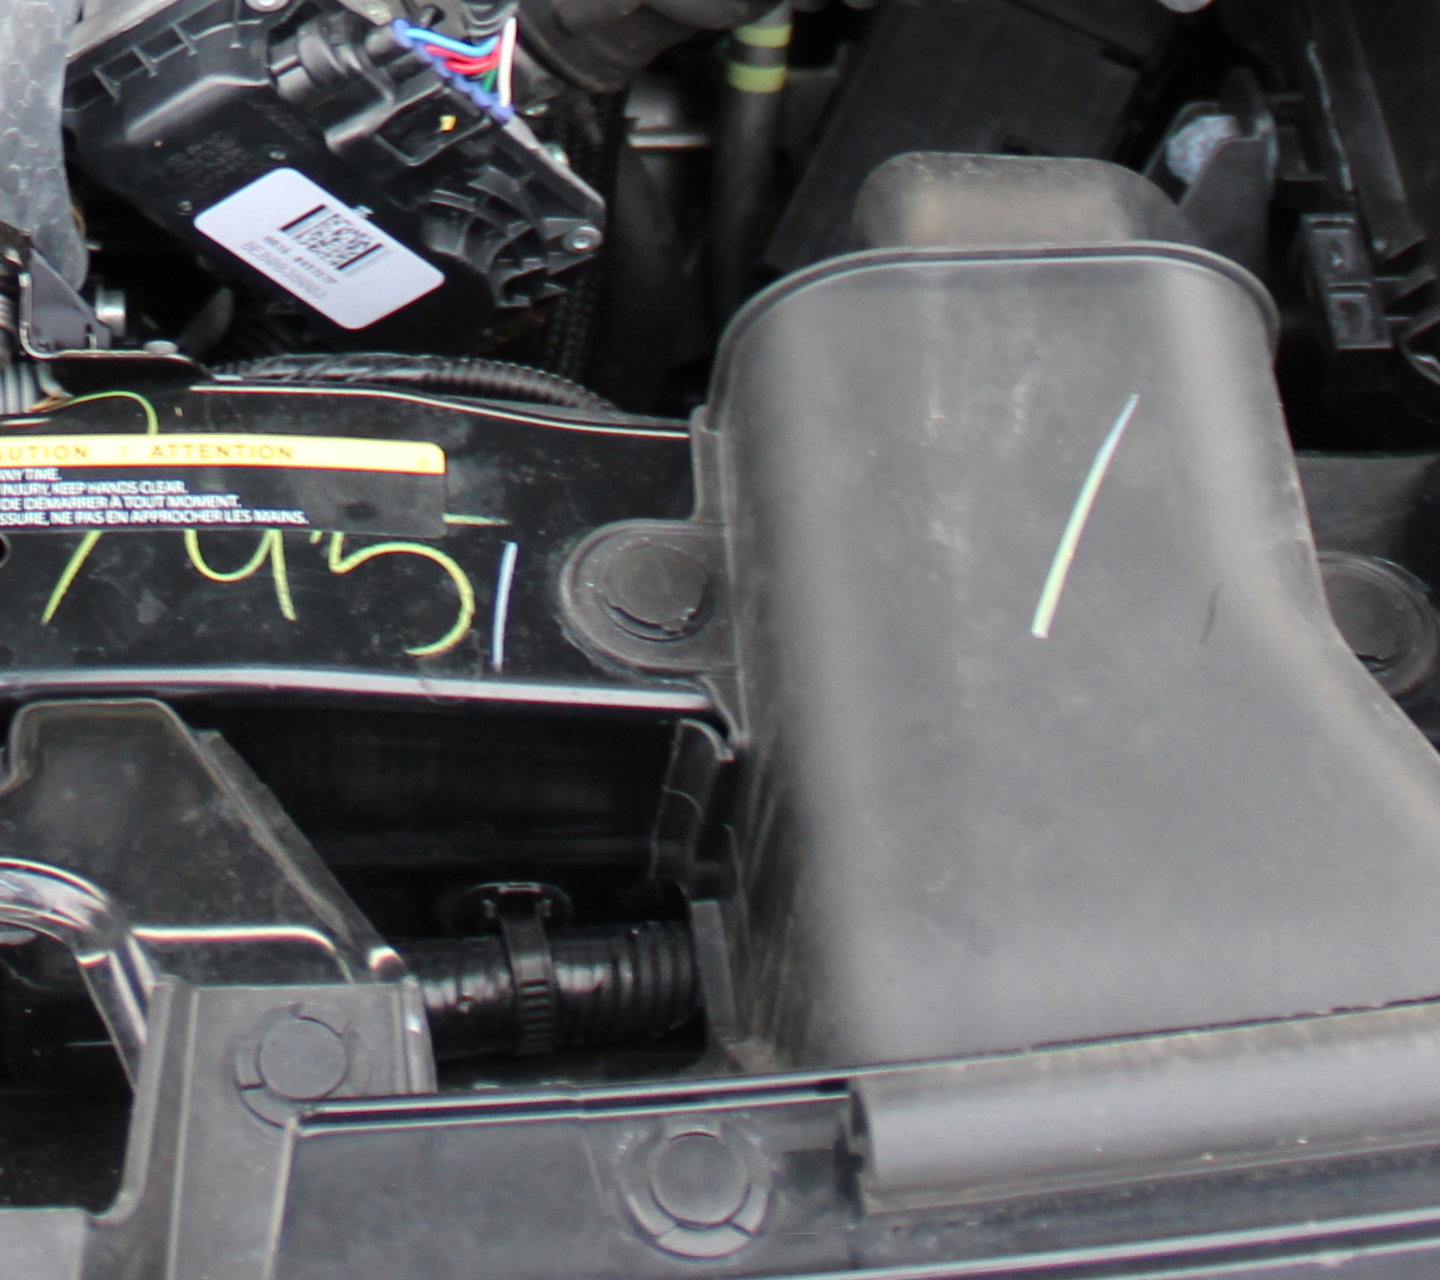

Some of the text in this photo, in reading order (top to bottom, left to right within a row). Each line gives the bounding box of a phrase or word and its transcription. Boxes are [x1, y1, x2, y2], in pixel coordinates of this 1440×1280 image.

[151, 443, 295, 460] ATTENTION
[51, 481, 87, 495] KEEP
[87, 481, 139, 495] HANDS
[139, 480, 188, 494] CLEAR.
[0, 497, 23, 511] DE
[121, 495, 165, 509] TOUT
[165, 494, 242, 508] MOMENT.
[50, 511, 74, 525] NE
[74, 511, 105, 525] PAS
[105, 510, 129, 524] EN
[129, 509, 223, 524] APPROCHER
[223, 509, 253, 523] LES
[253, 509, 310, 525] MAINS.
